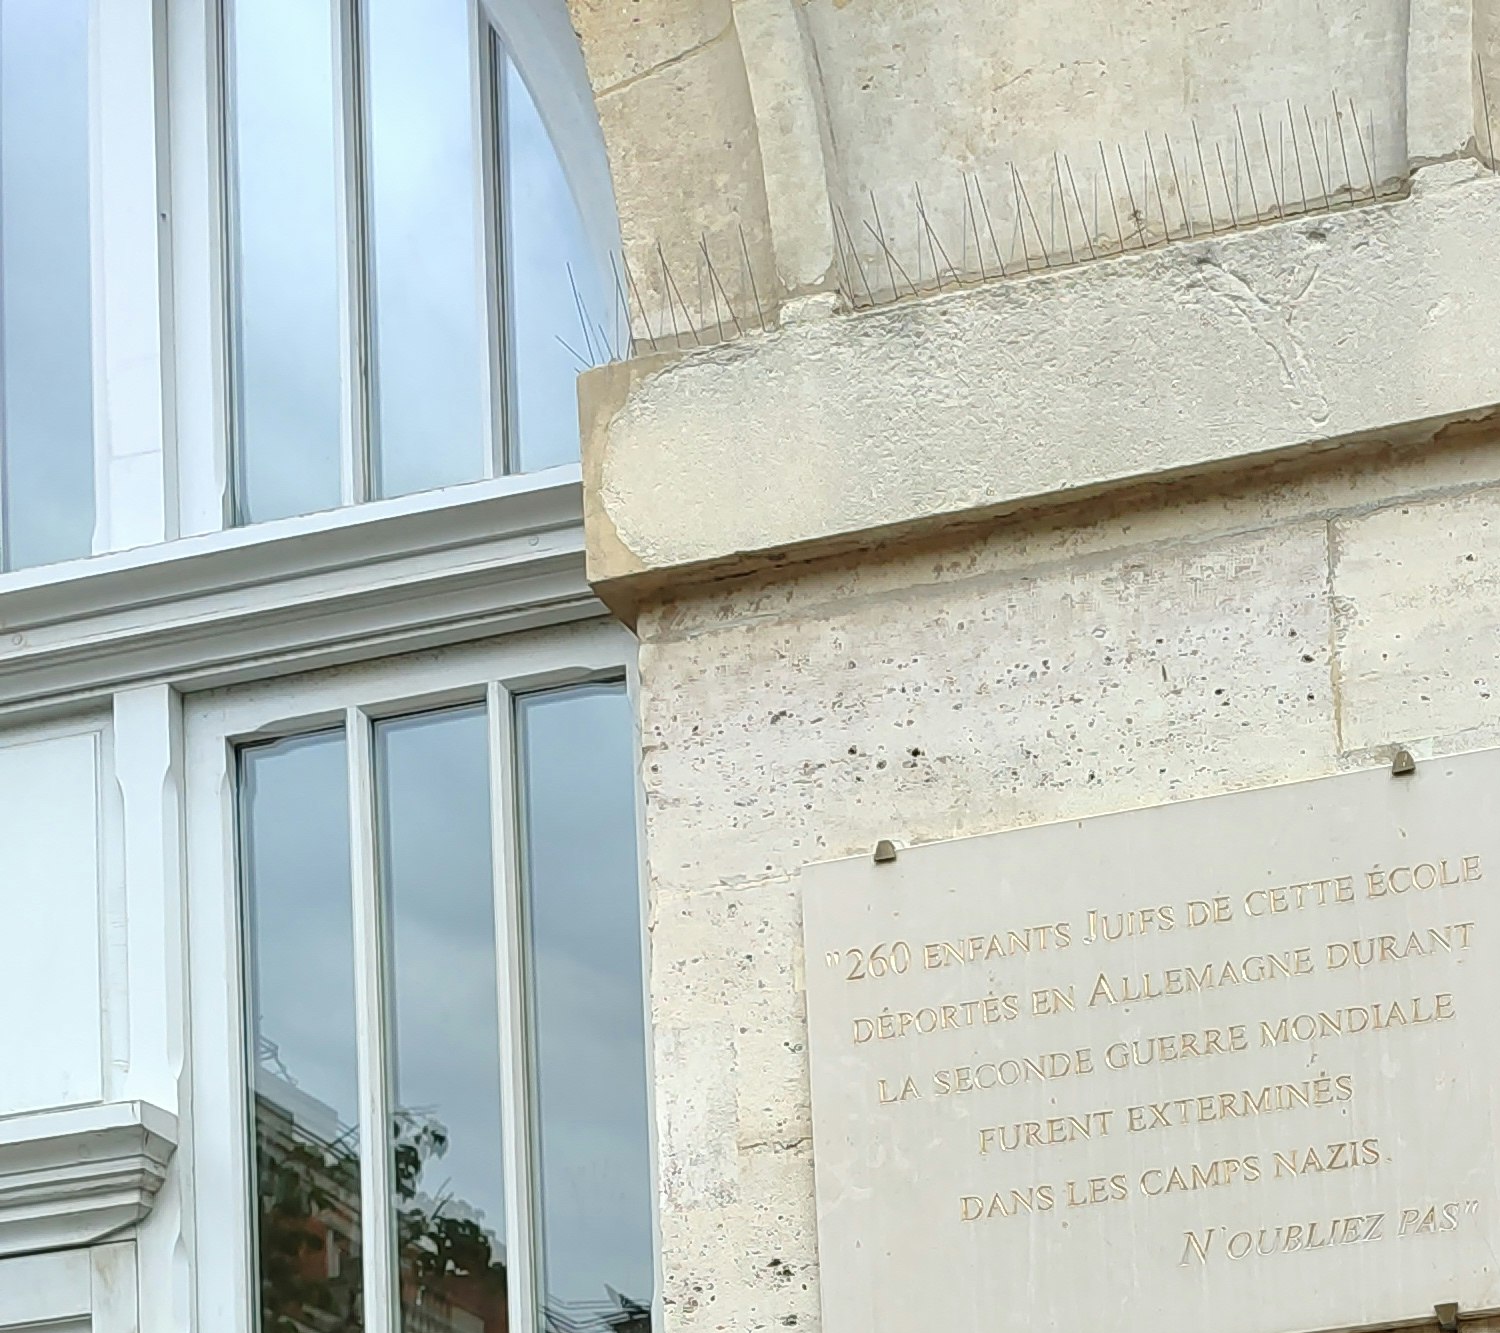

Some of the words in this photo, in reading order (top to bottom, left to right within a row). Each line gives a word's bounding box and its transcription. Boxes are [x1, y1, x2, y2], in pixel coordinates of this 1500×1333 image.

[923, 922, 1071, 970] ENFANTS
[1082, 908, 1176, 946] JUIFS
[1187, 899, 1233, 929] DE
[1244, 875, 1355, 918] CETTE
[1365, 854, 1483, 899] ÉCOLE
[853, 990, 1019, 1044] DÉPORTÉS
[1031, 985, 1076, 1016] EN
[1088, 947, 1315, 1007] ALLEMAGNE
[1326, 921, 1475, 971] DURANT
[878, 1076, 922, 1105] LA
[933, 1048, 1094, 1096] SECONDE
[1104, 1024, 1249, 1070] GUERRE
[1259, 992, 1456, 1048] MONDIALE
[978, 1110, 1113, 1155] FURENT
[1127, 1070, 1354, 1133] EXTERMINÉS
[960, 1185, 1054, 1222] DANS
[1066, 1174, 1128, 1207] LES
[1140, 1154, 1261, 1198] CAMPS
[1180, 1212, 1386, 1267] N'OUBLIEZ
